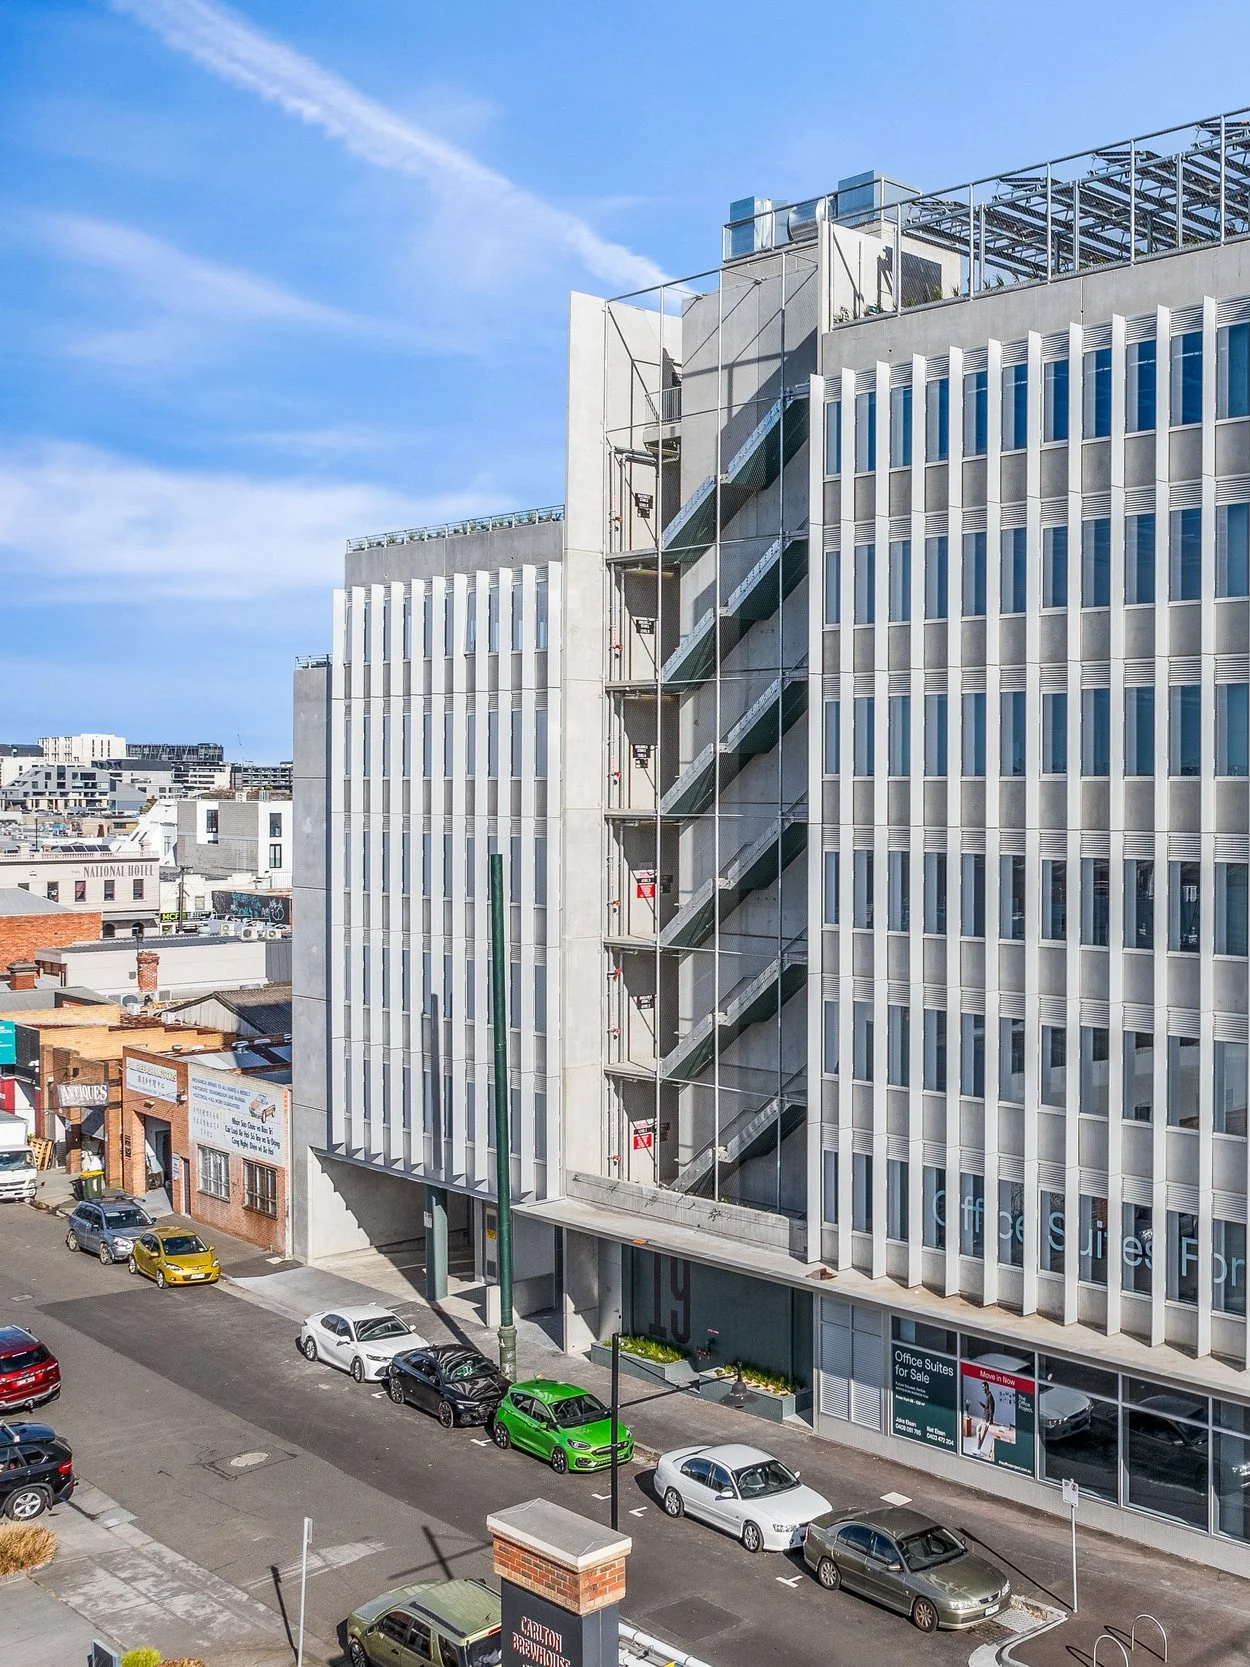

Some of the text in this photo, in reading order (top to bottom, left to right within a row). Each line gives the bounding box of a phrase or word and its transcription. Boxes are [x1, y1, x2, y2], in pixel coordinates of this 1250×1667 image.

[83, 865, 126, 877] NATIONAL
[128, 864, 153, 876] HOTEL
[61, 1084, 108, 1100] ANTIQUES
[1181, 1237, 1245, 1287] For
[649, 1253, 691, 1344] 19
[895, 1350, 954, 1377] Office Suites
[895, 1364, 930, 1384] for Sale
[980, 1370, 996, 1381] Move
[1002, 1376, 1016, 1386] Now
[520, 1616, 562, 1653] CARLTON
